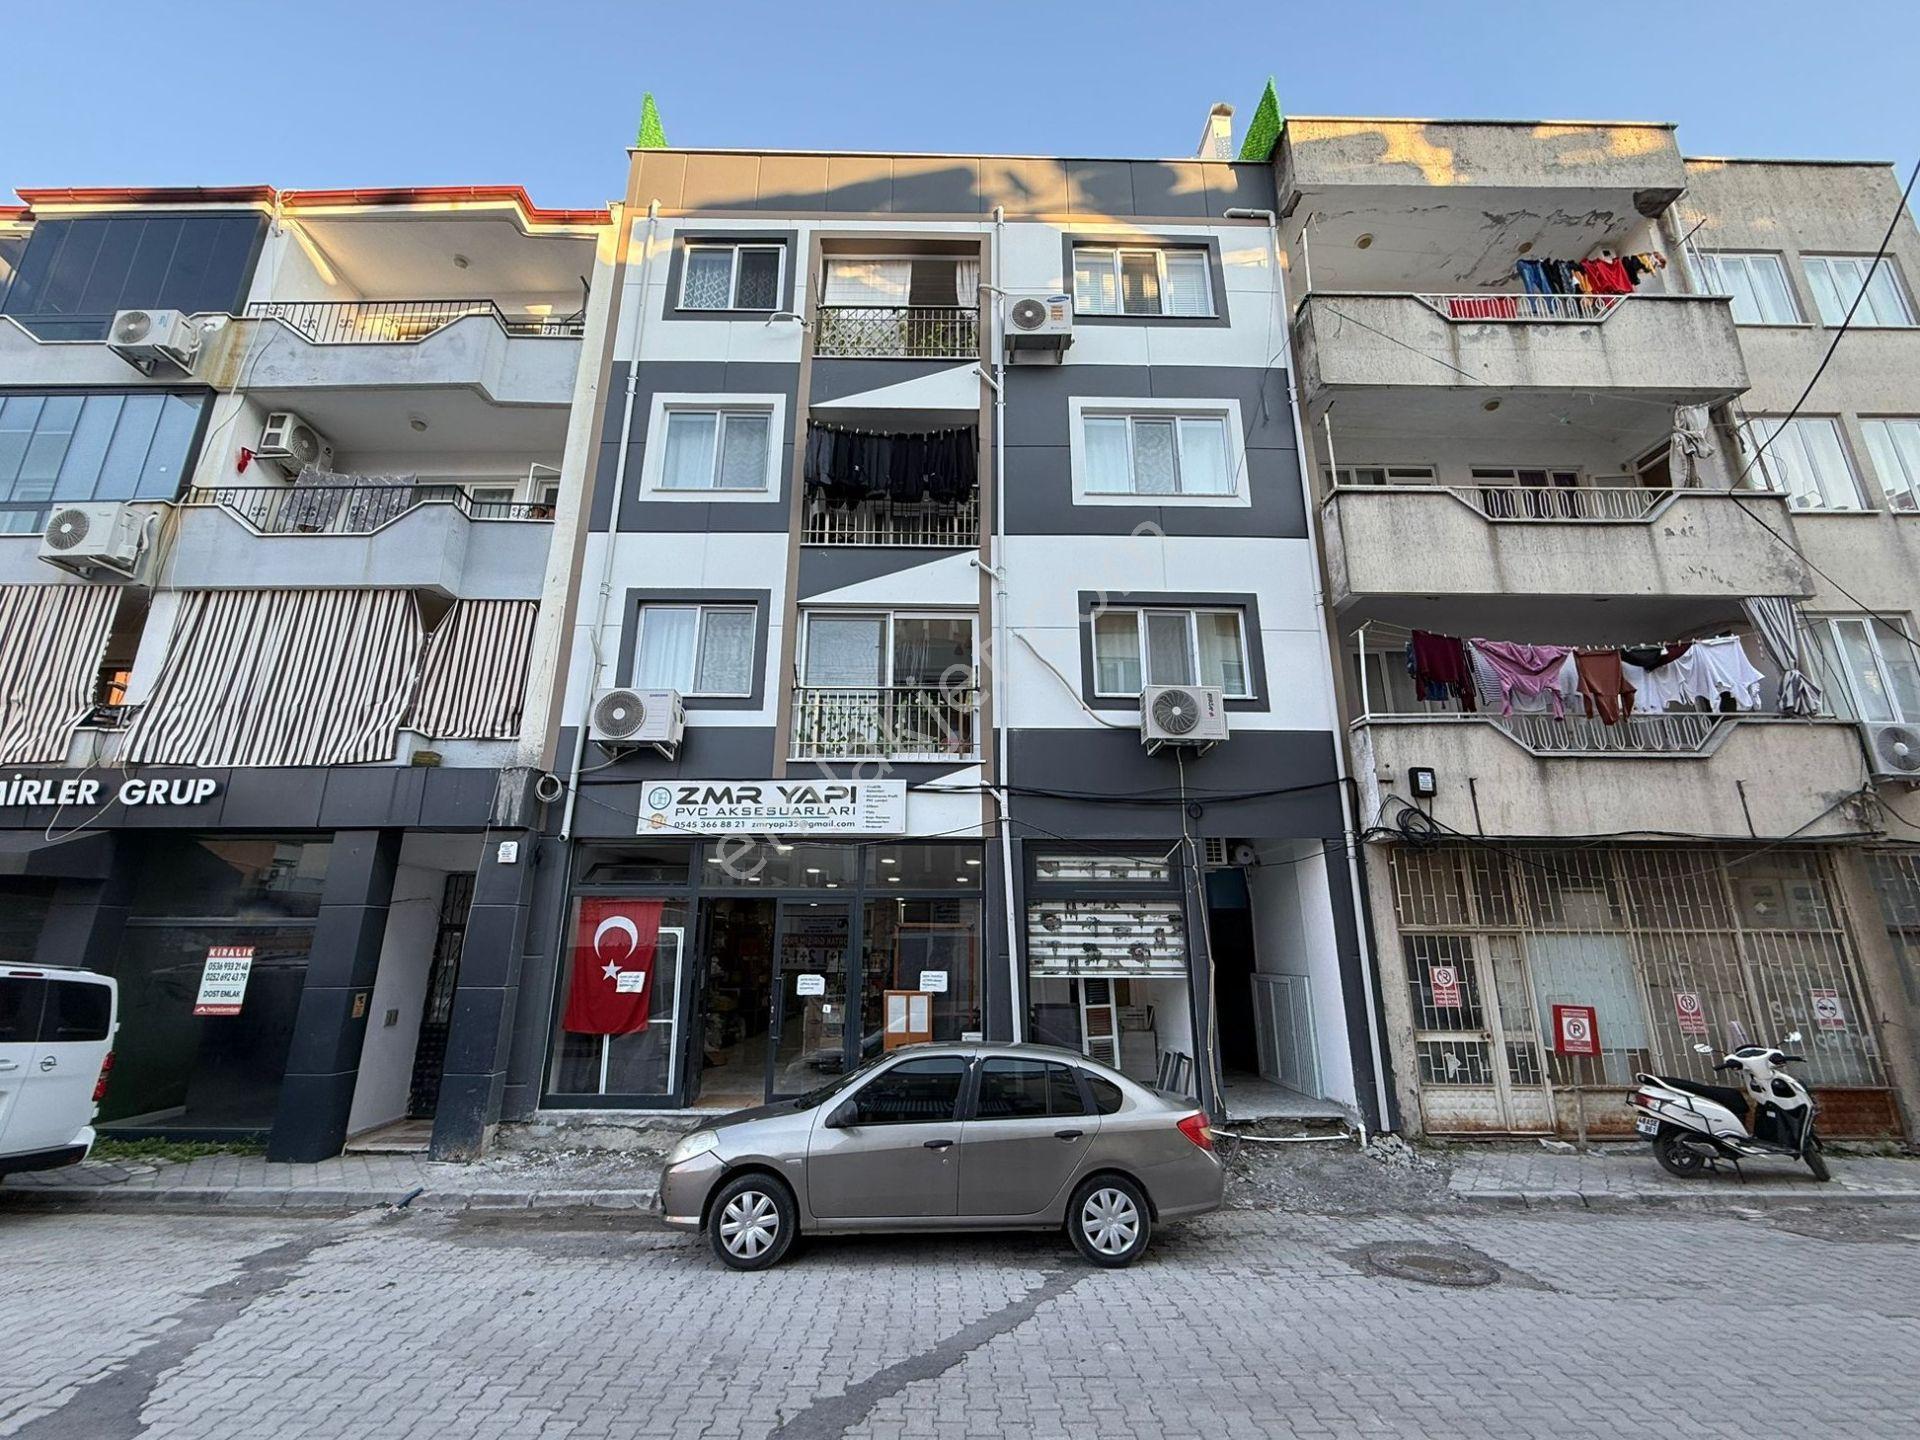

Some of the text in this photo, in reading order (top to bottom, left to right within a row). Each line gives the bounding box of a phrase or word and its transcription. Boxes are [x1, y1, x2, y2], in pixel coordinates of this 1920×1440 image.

[118, 778, 217, 806] GRUP
[675, 785, 857, 805] ZMR YAPI
[675, 806, 856, 816] PVC AKSESUARLARI
[674, 820, 698, 829] 0545
[701, 820, 718, 829] 366
[720, 820, 734, 829] 88
[735, 820, 746, 828] 21
[203, 990, 241, 998] DOST EMLAK
